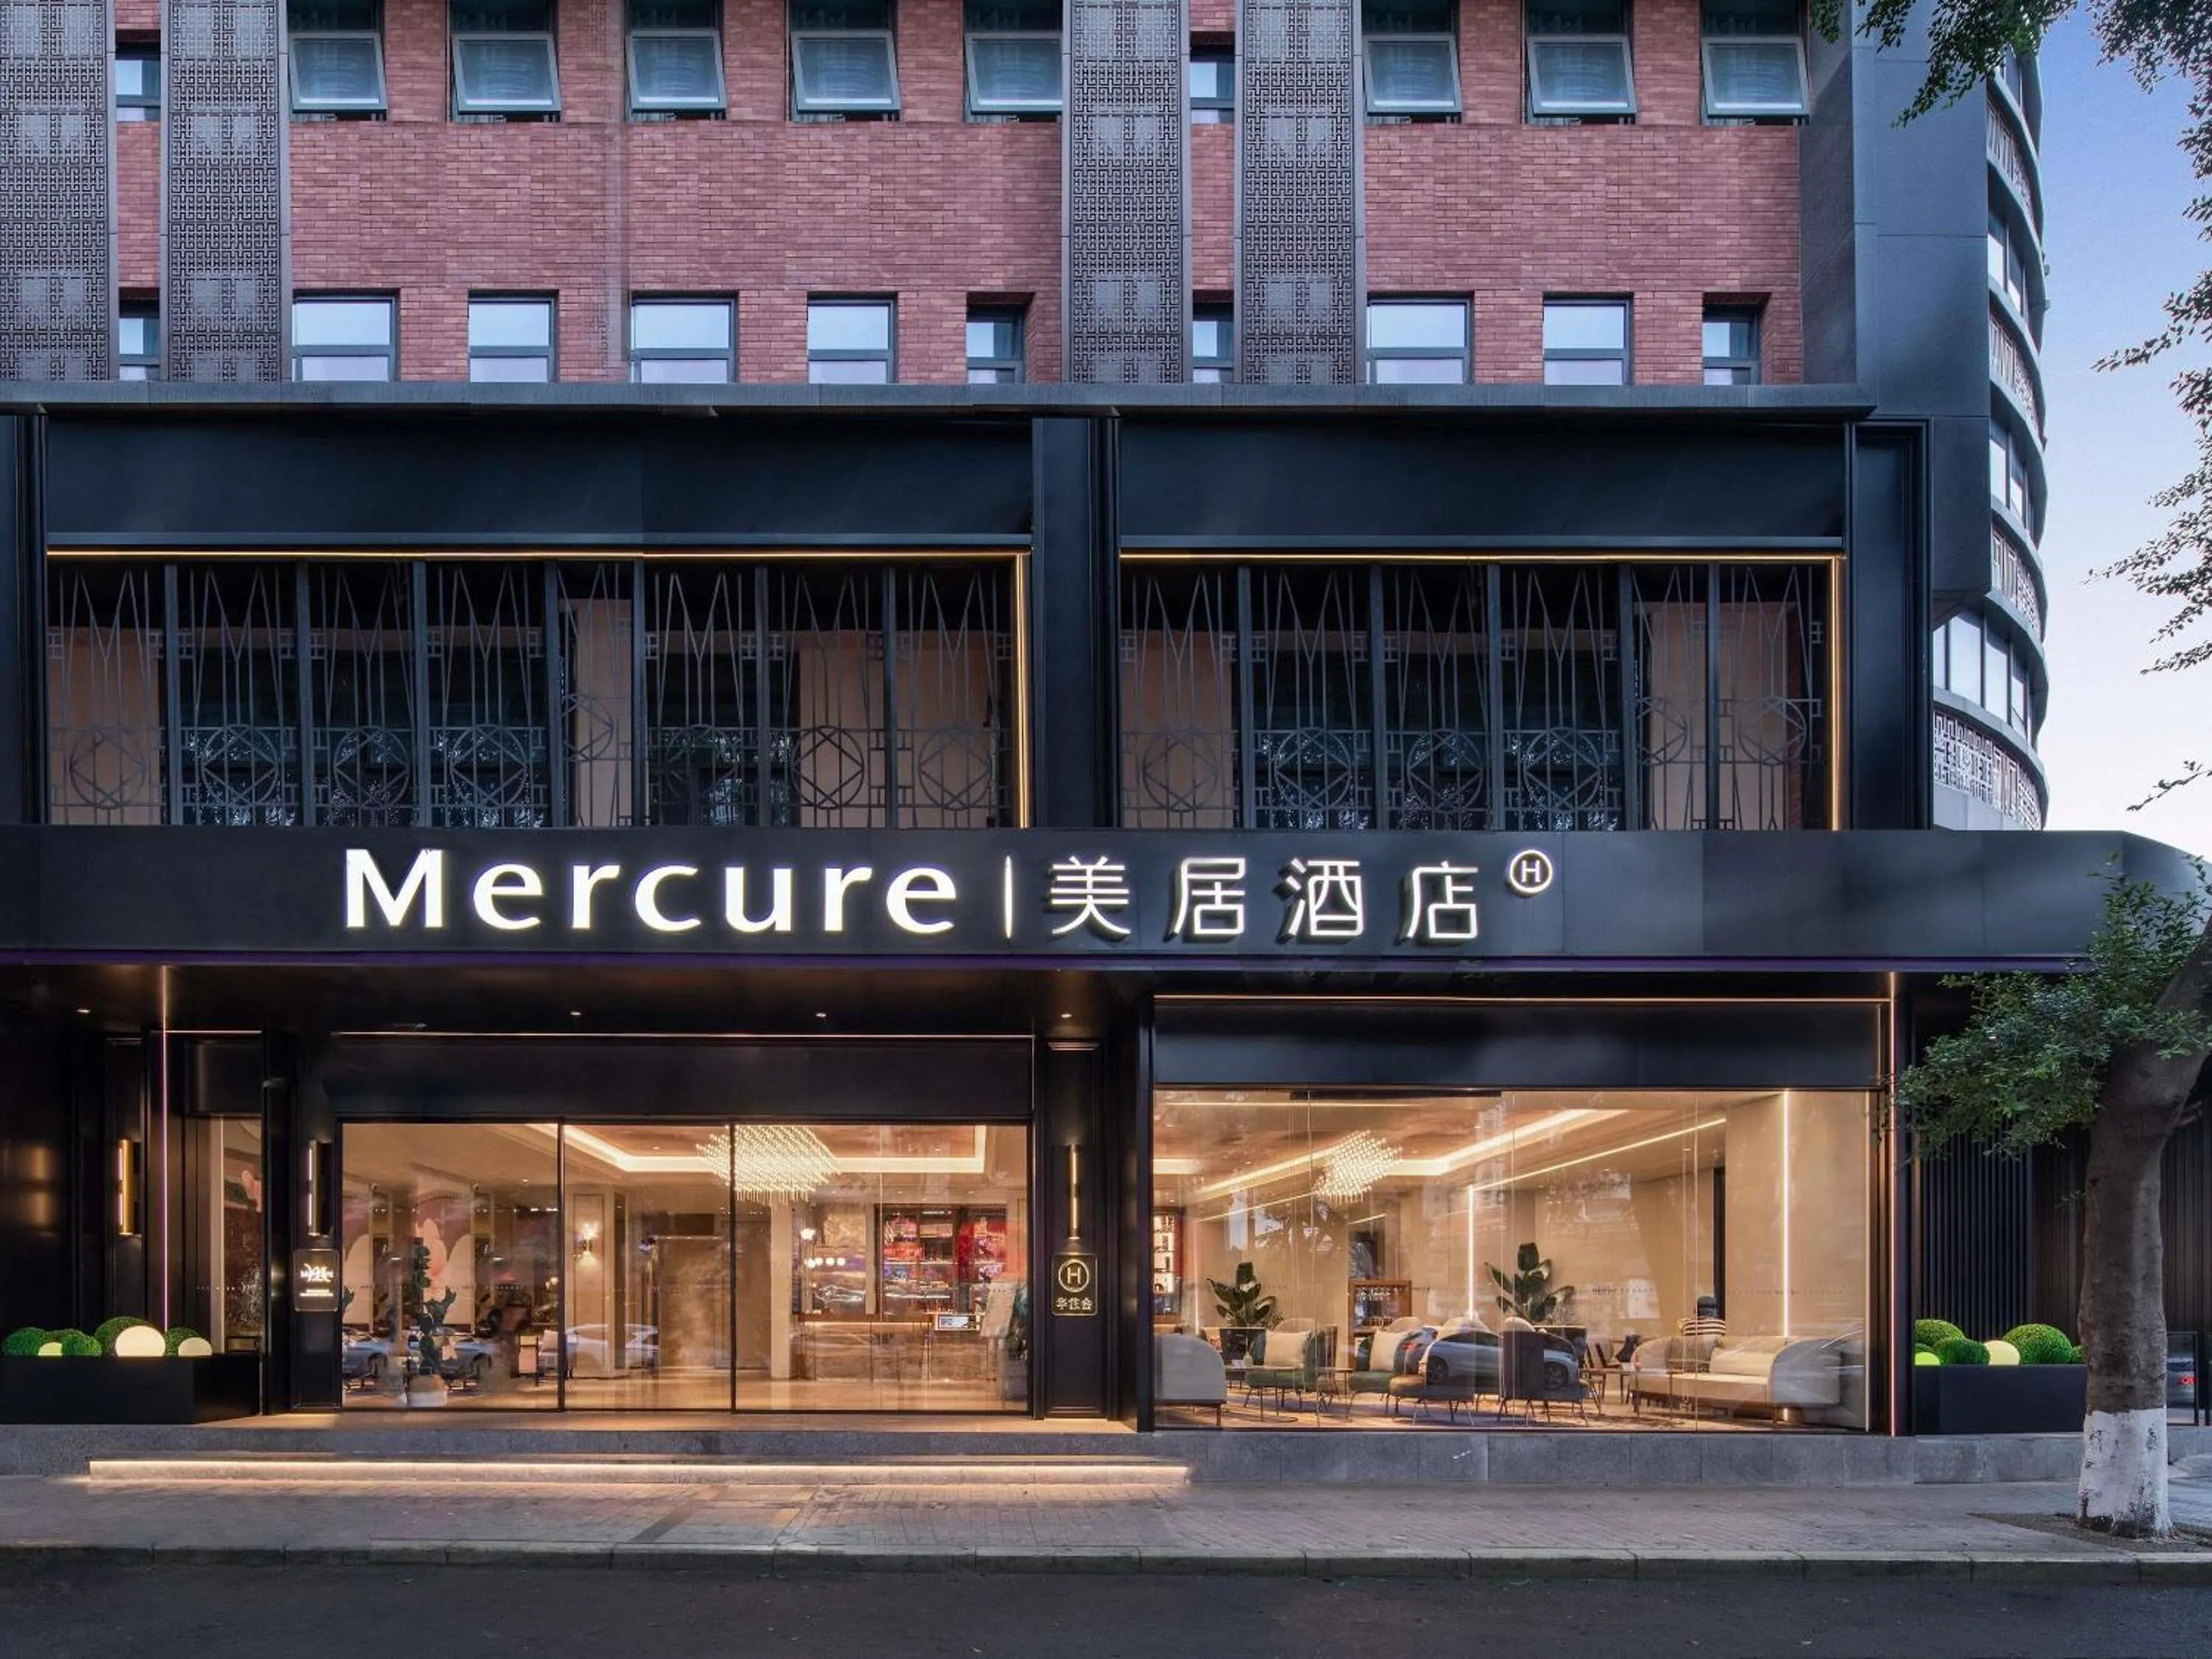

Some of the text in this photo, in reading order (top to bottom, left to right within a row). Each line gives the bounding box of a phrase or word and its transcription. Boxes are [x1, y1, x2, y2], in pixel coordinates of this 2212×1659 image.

[346, 849, 957, 934] Mercure
[1051, 855, 1478, 939] 美居酒店
